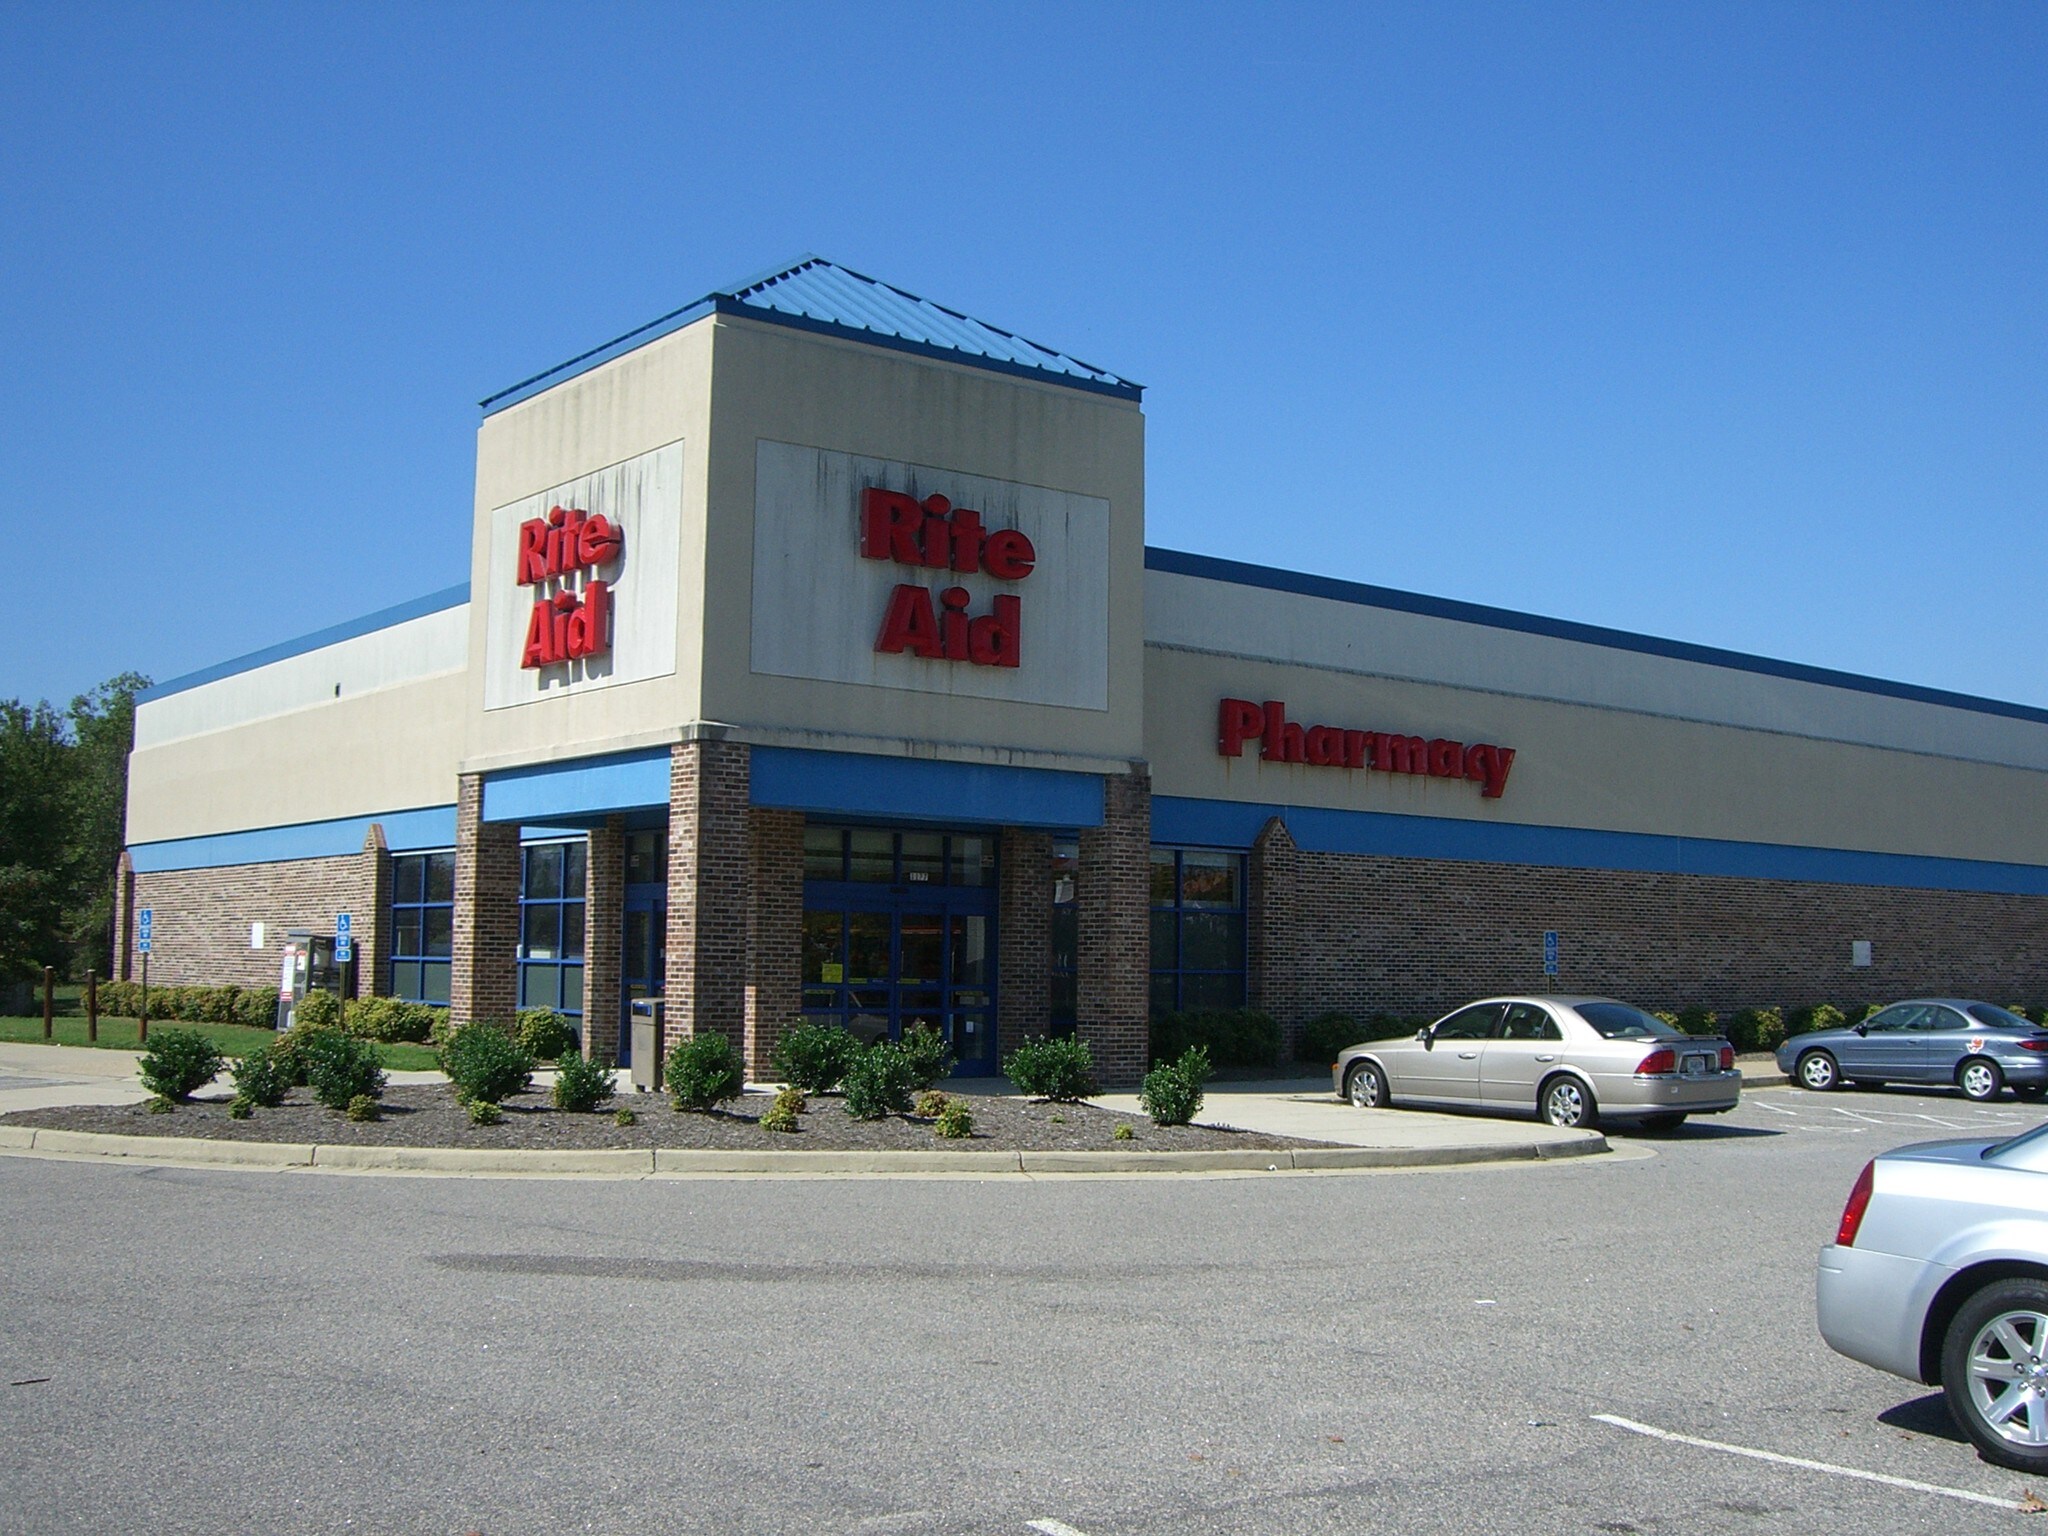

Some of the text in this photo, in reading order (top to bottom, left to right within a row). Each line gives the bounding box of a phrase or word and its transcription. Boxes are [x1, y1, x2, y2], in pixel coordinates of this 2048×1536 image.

[516, 504, 620, 586] Rite
[861, 487, 1035, 580] Rite
[520, 580, 609, 669] Aid
[875, 584, 1020, 668] Aid
[1219, 698, 1516, 798] Pharmacy
